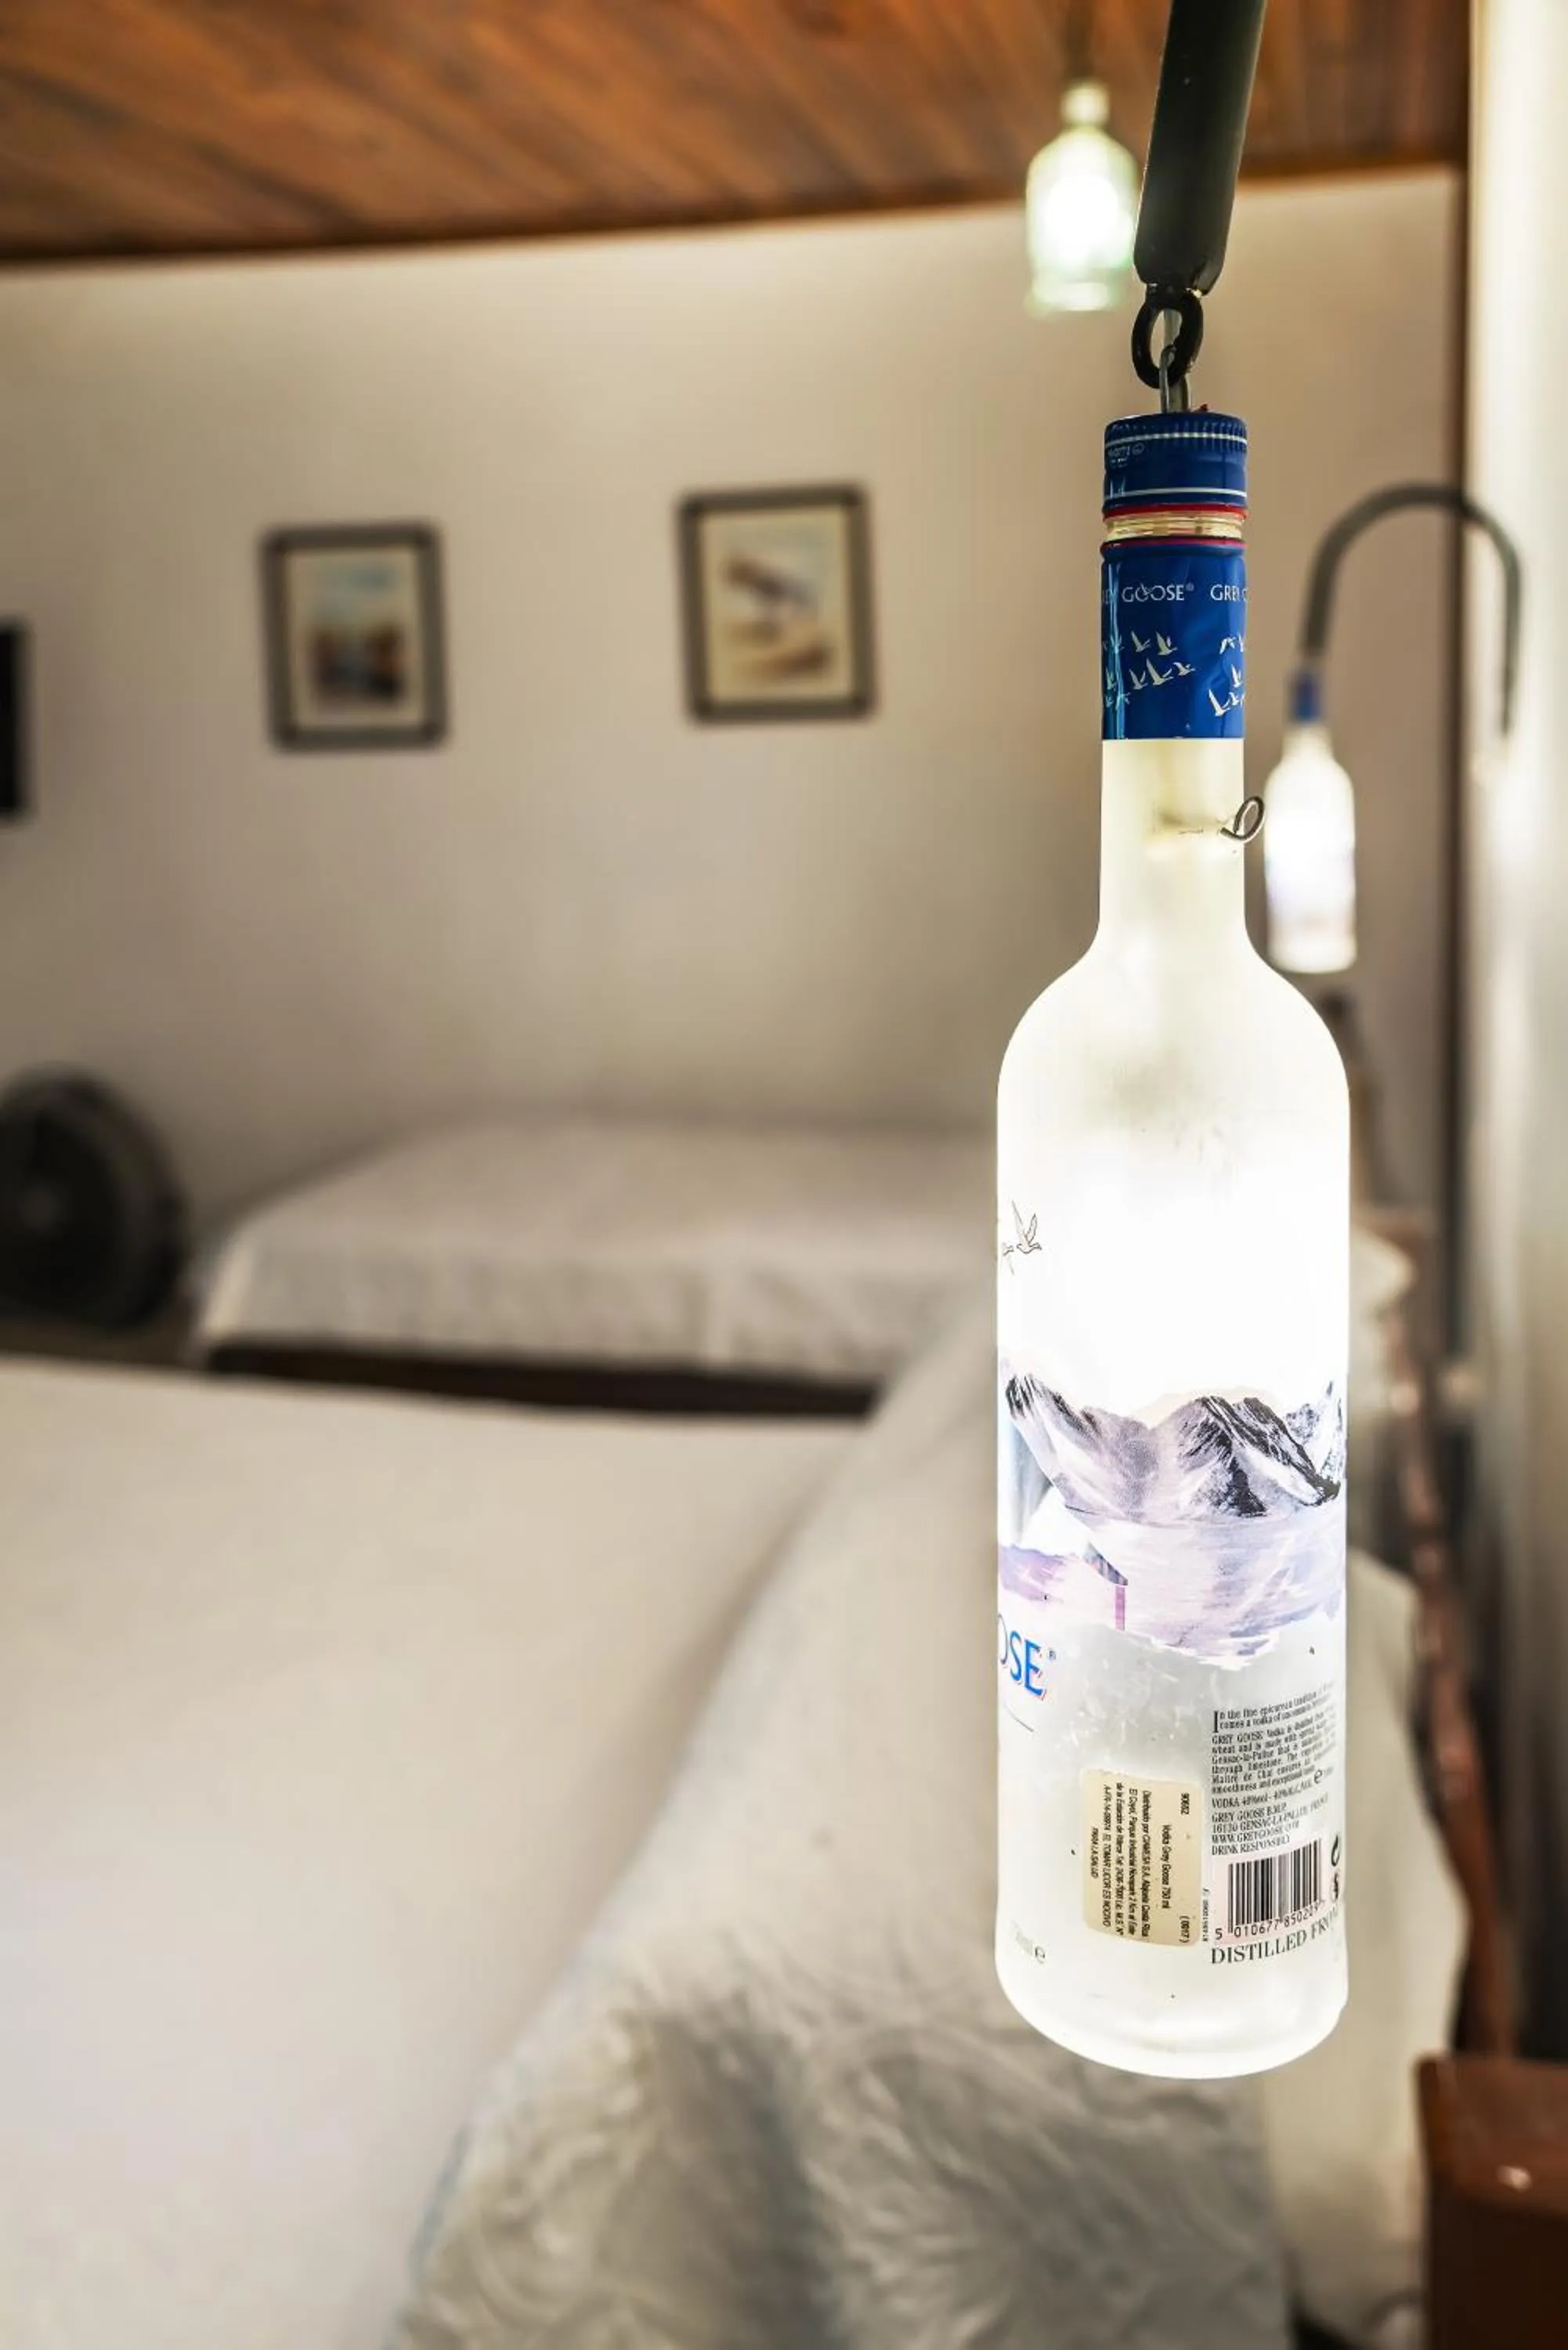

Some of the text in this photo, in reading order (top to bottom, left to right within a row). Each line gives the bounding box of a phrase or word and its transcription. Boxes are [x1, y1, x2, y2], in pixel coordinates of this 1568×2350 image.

[1212, 1797, 1240, 1808] VODKA
[1212, 1812, 1235, 1822] GREY
[1212, 1845, 1237, 1856] DRINK
[1215, 1928, 1223, 1940] 5
[1212, 1929, 1307, 1964] DISTILLED
